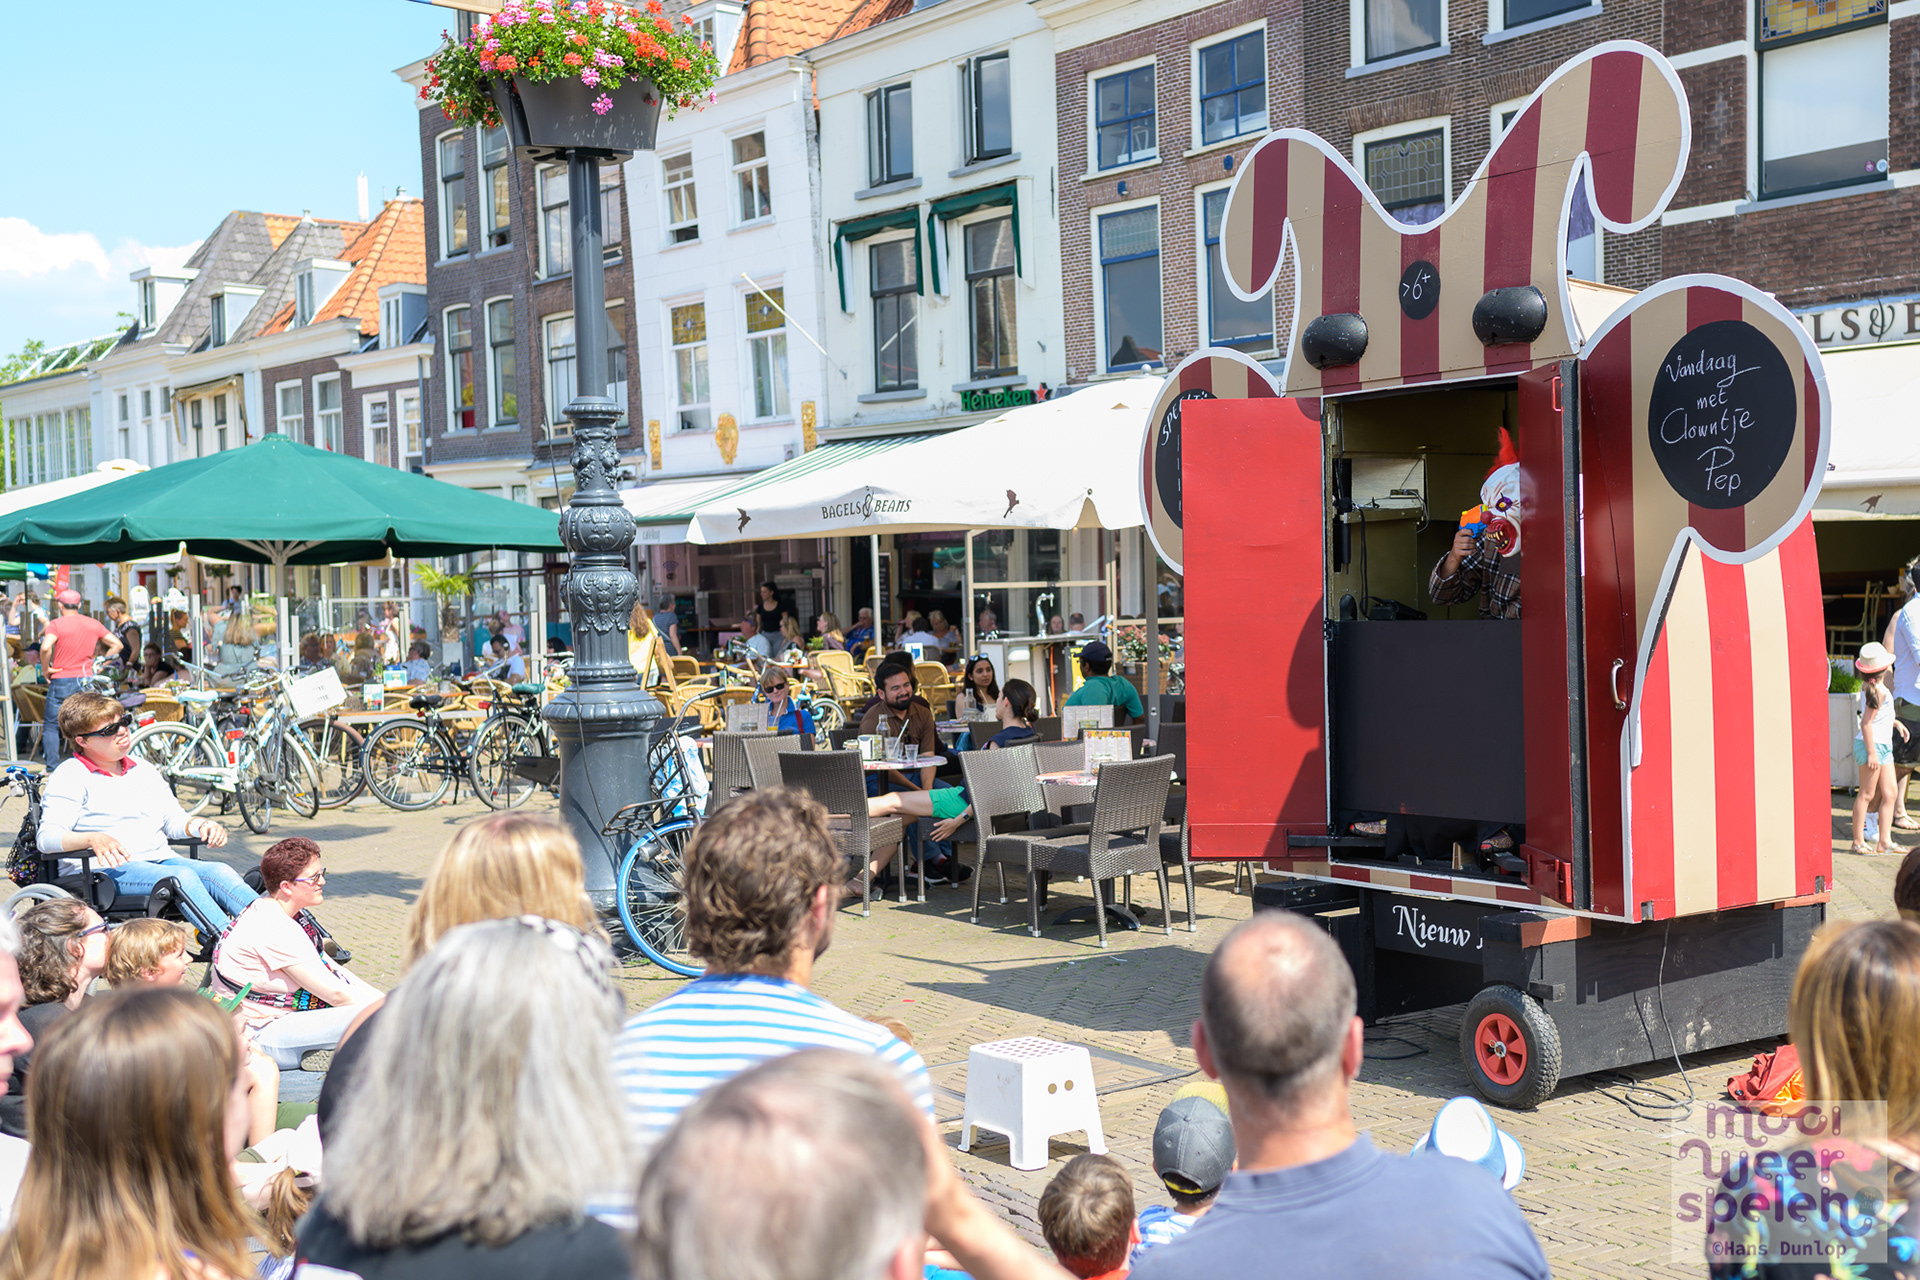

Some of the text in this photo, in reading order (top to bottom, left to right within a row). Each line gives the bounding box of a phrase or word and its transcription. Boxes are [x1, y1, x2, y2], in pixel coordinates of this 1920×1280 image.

[1665, 349, 1762, 388] Vandaag
[960, 386, 1032, 412] Heineken
[1696, 387, 1728, 409] met
[1660, 407, 1756, 444] Clowntje
[1696, 445, 1742, 496] Pep
[821, 501, 862, 519] BAGELS
[873, 500, 912, 513] BEANS
[1392, 905, 1471, 948] Nieuw
